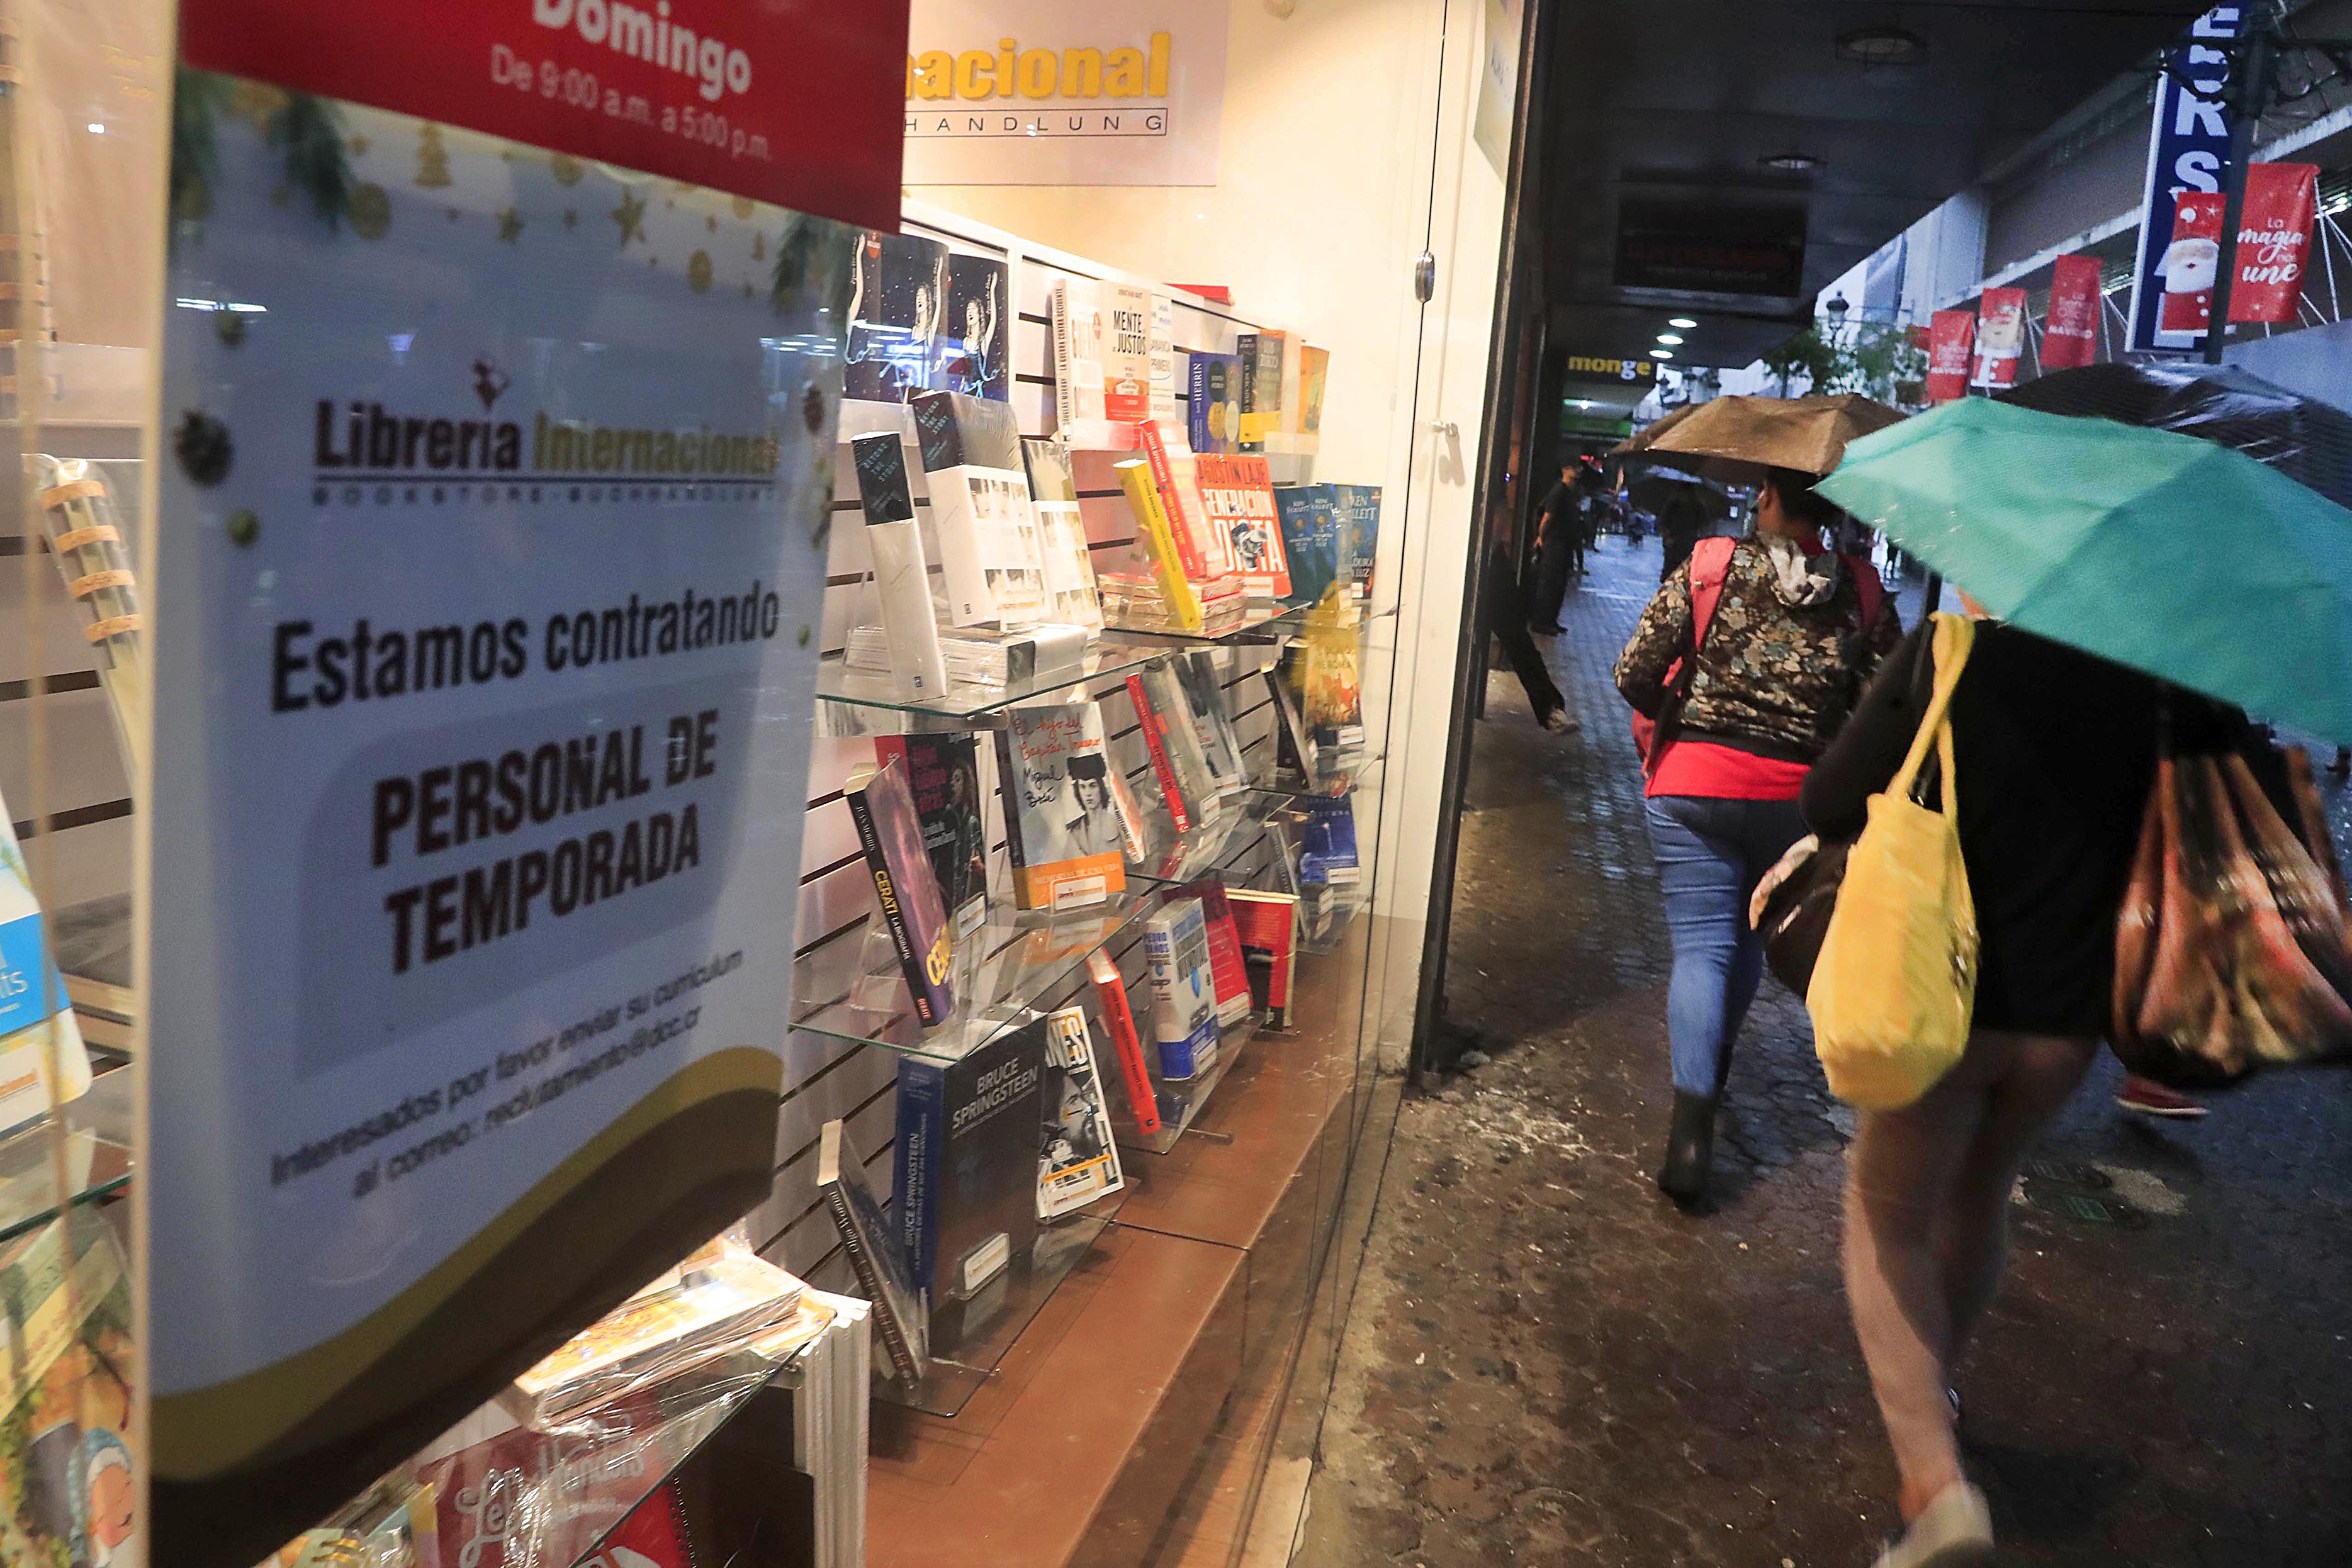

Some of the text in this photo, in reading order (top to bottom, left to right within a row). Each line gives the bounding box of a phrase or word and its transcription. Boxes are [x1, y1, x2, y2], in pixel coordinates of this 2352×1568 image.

[906, 32, 1170, 100] acional
[492, 44, 532, 91] De
[539, 60, 599, 108] 9:00
[661, 106, 677, 133] a
[682, 106, 728, 147] 5:00
[2242, 264, 2300, 285] une
[1113, 310, 1142, 333] MENTE
[1117, 333, 1147, 356] JUSTOS
[1193, 362, 1203, 401] HERRIN
[1568, 356, 1651, 380] monge
[271, 580, 780, 714] Estamos contratando
[371, 708, 719, 870] PERSONAL DE
[385, 803, 700, 974] TEMPORADA
[874, 870, 900, 915] CERATI
[271, 1087, 442, 1187] Interesados
[447, 1067, 489, 1112] por
[495, 1036, 556, 1081] favor
[558, 1007, 621, 1052] enviar
[626, 994, 651, 1021] su
[951, 1065, 1039, 1130] SPRINGSTEEN
[976, 1057, 1019, 1095] BRUCE
[352, 1158, 381, 1199] al
